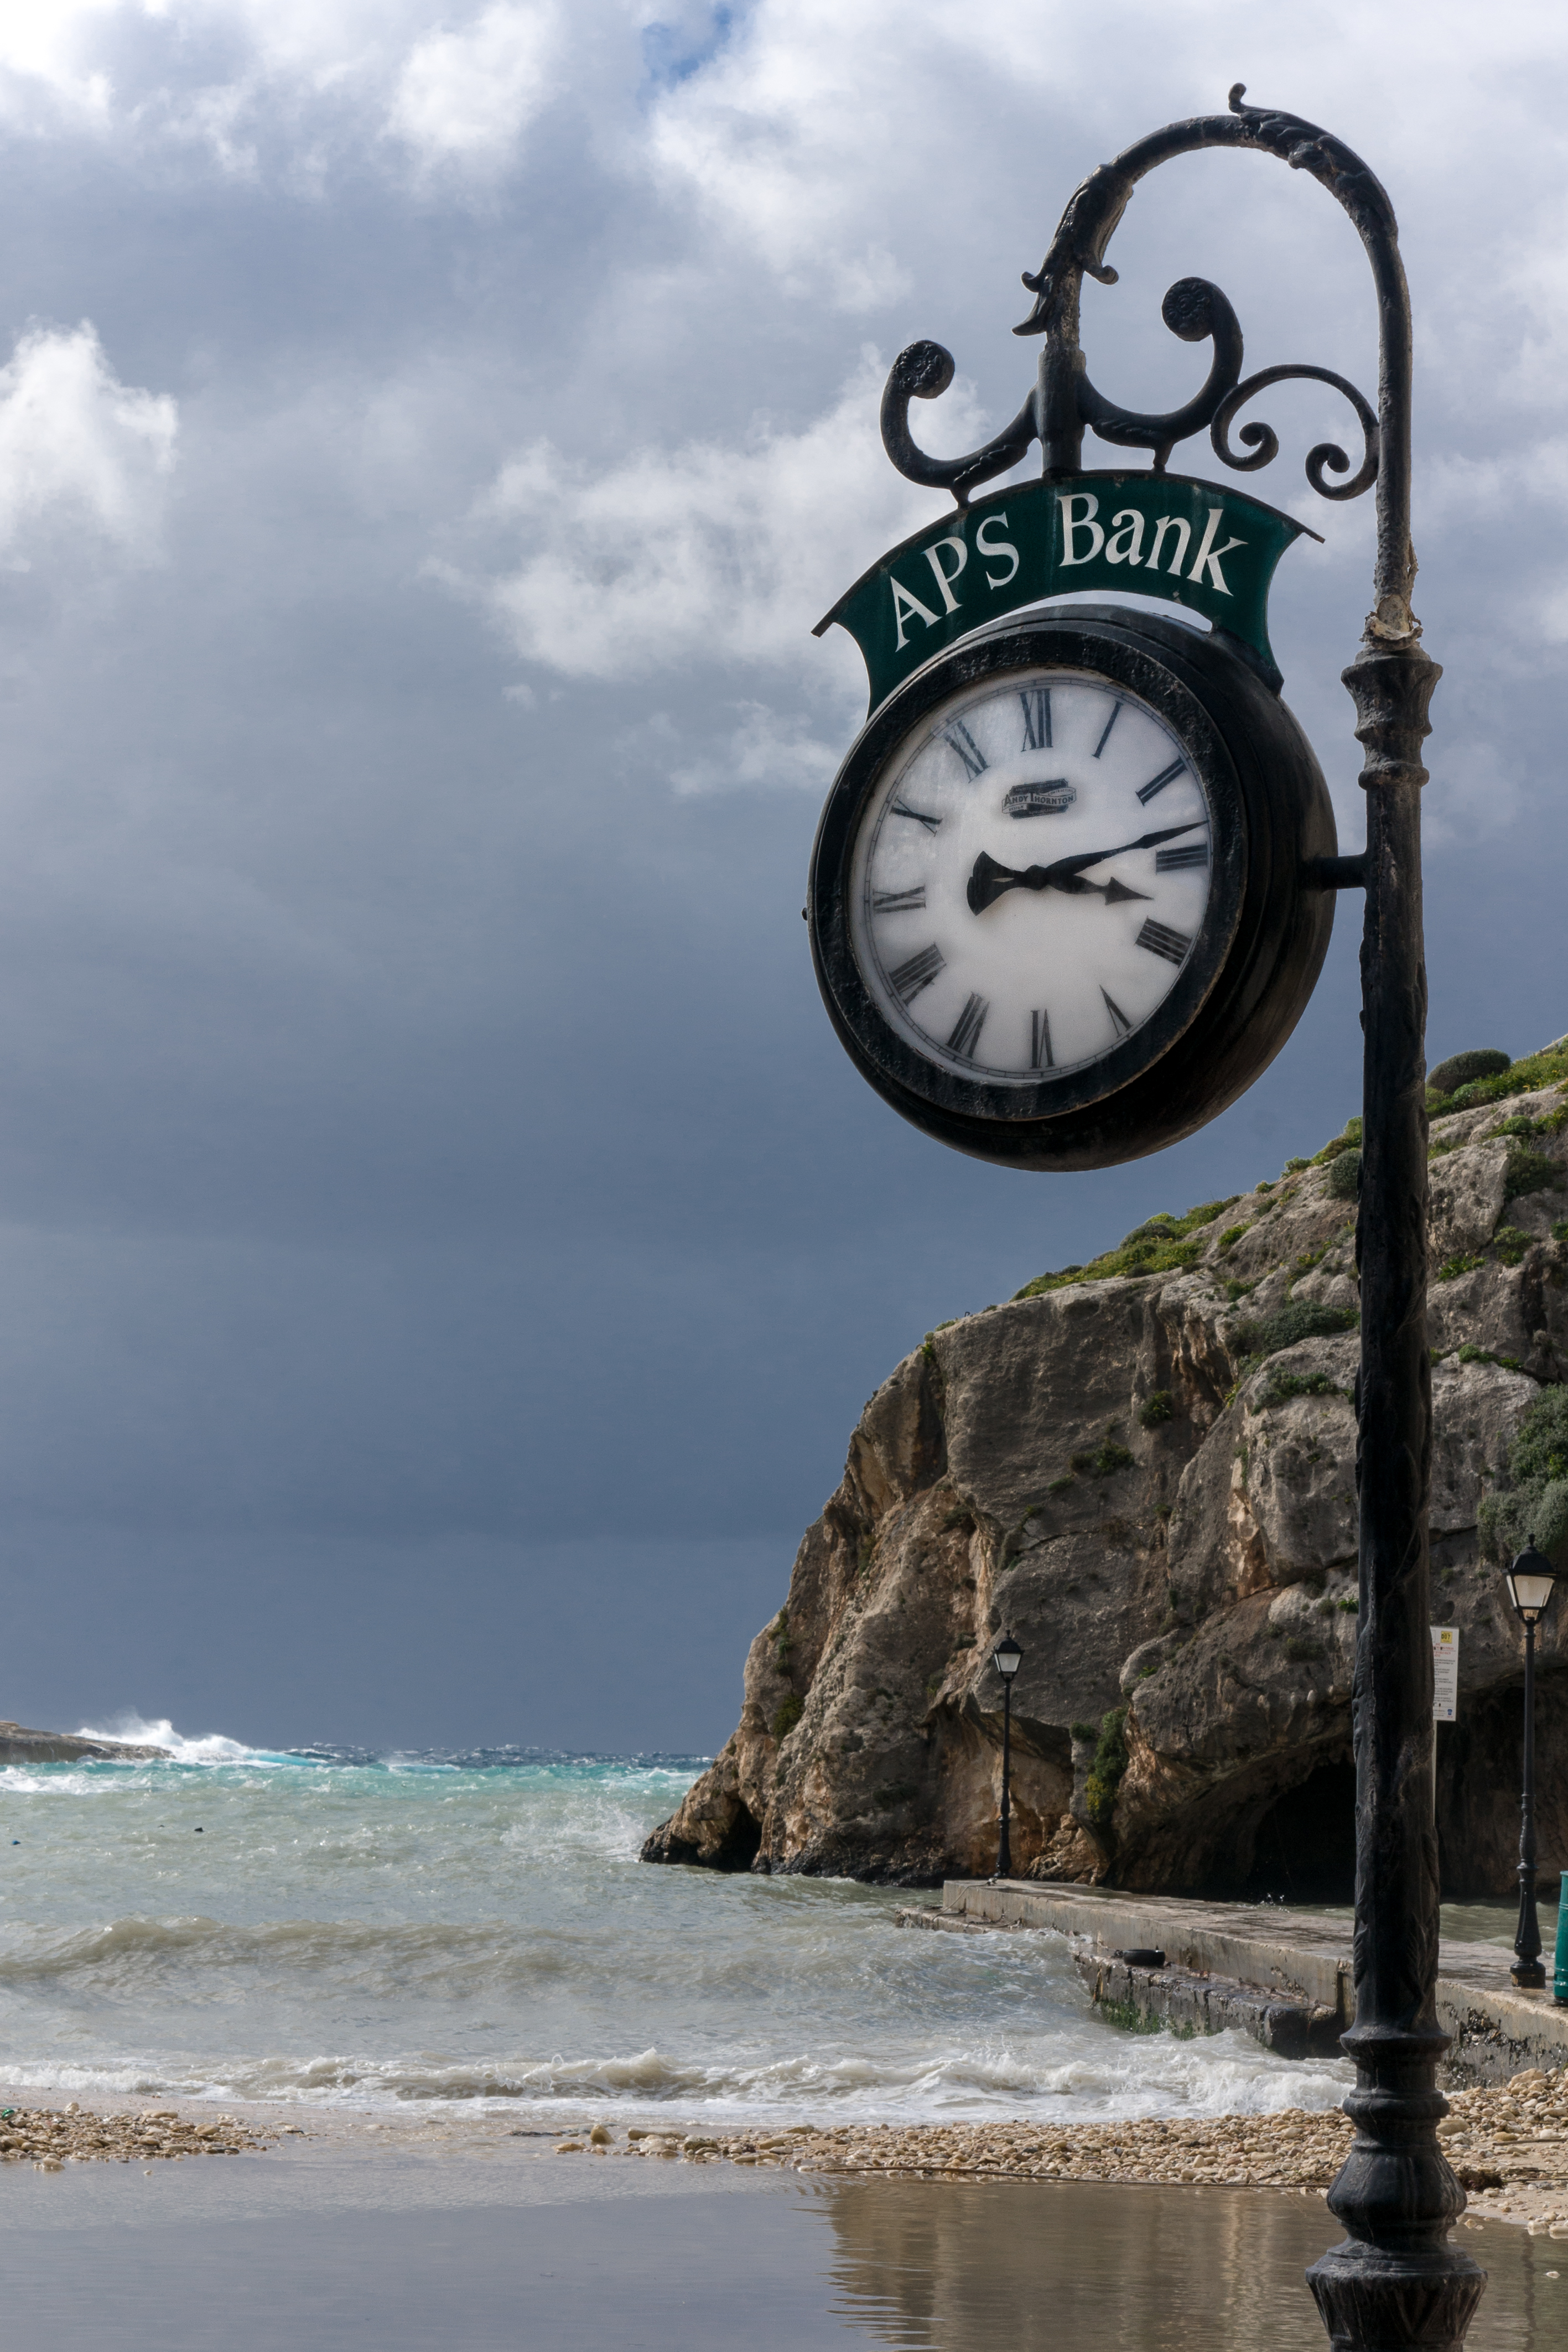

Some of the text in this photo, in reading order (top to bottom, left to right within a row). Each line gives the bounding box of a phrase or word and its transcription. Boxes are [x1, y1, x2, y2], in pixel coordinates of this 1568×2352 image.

[890, 493, 1249, 652] APS Bank
[1019, 688, 1052, 751] XII
[1092, 701, 1123, 758] I
[943, 720, 990, 782] XI
[1004, 792, 1073, 807] ANDY THORNTON
[1135, 756, 1188, 805] II
[890, 798, 942, 836] X
[1156, 842, 1207, 872] III
[873, 886, 926, 914] IX
[1134, 915, 1192, 968] IIII
[888, 942, 947, 1006] VIII
[947, 992, 989, 1057] VII
[1030, 1009, 1055, 1068] VI
[1100, 985, 1133, 1037] V
